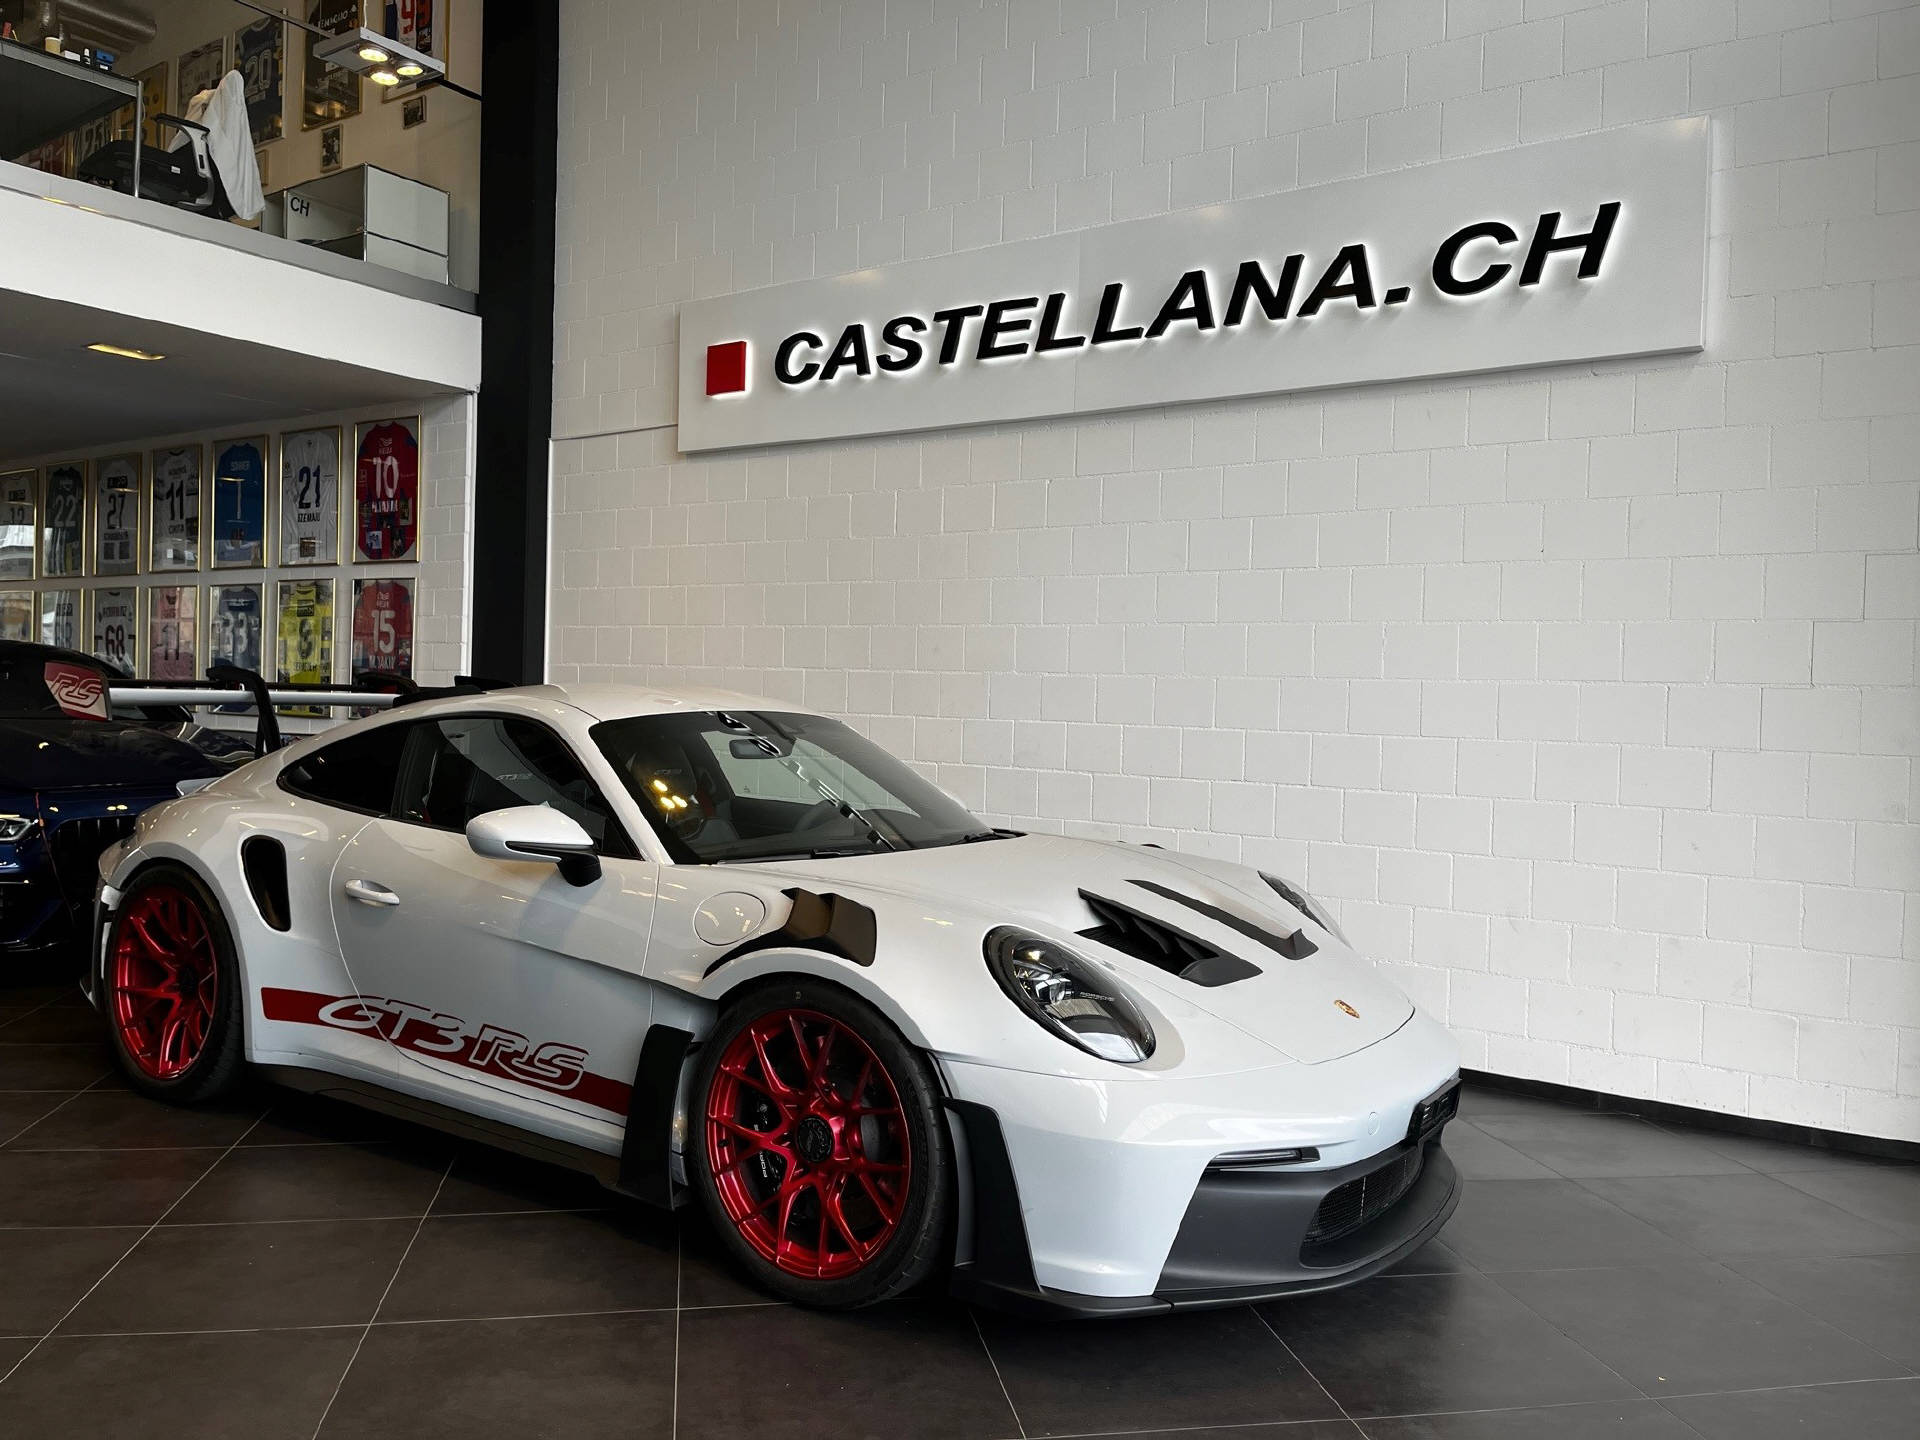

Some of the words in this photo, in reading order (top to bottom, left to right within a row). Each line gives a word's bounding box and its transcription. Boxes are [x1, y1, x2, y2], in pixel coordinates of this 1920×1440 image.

[290, 196, 310, 216] CH
[773, 202, 1622, 386] CASTELLANA.CH
[298, 465, 321, 509] 21
[373, 456, 399, 498] 10
[53, 495, 76, 527] 22
[107, 493, 126, 529] 27
[166, 480, 184, 520] 11
[105, 625, 125, 661] 68
[372, 609, 396, 654] 15
[50, 672, 102, 708] RS
